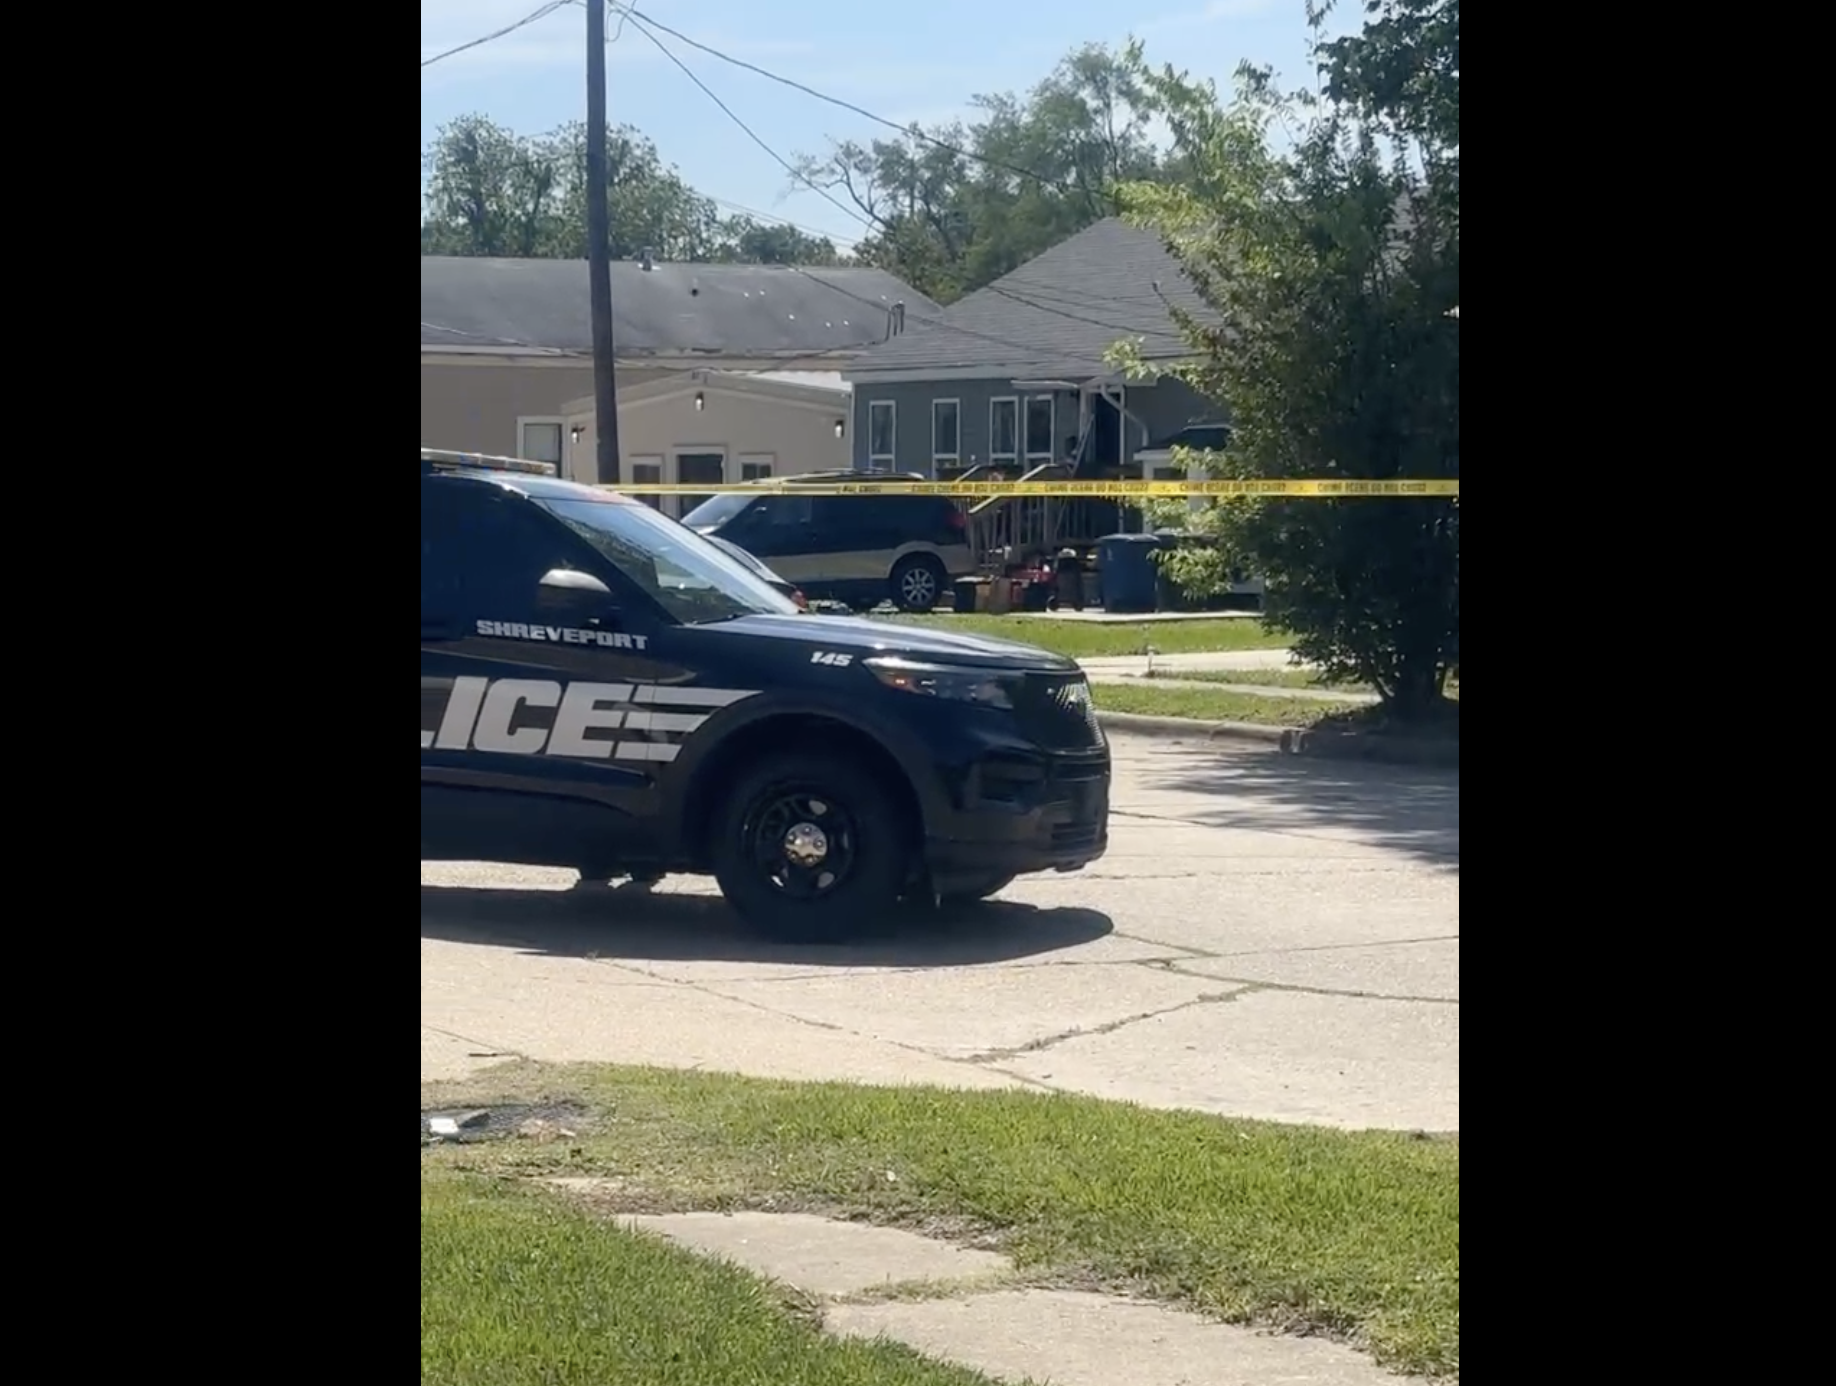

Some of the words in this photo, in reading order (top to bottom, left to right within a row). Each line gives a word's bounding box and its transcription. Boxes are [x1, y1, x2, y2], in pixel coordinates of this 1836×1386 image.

[476, 619, 648, 651] SHREVEPORT
[810, 651, 853, 667] 145
[421, 675, 633, 758] ICE
